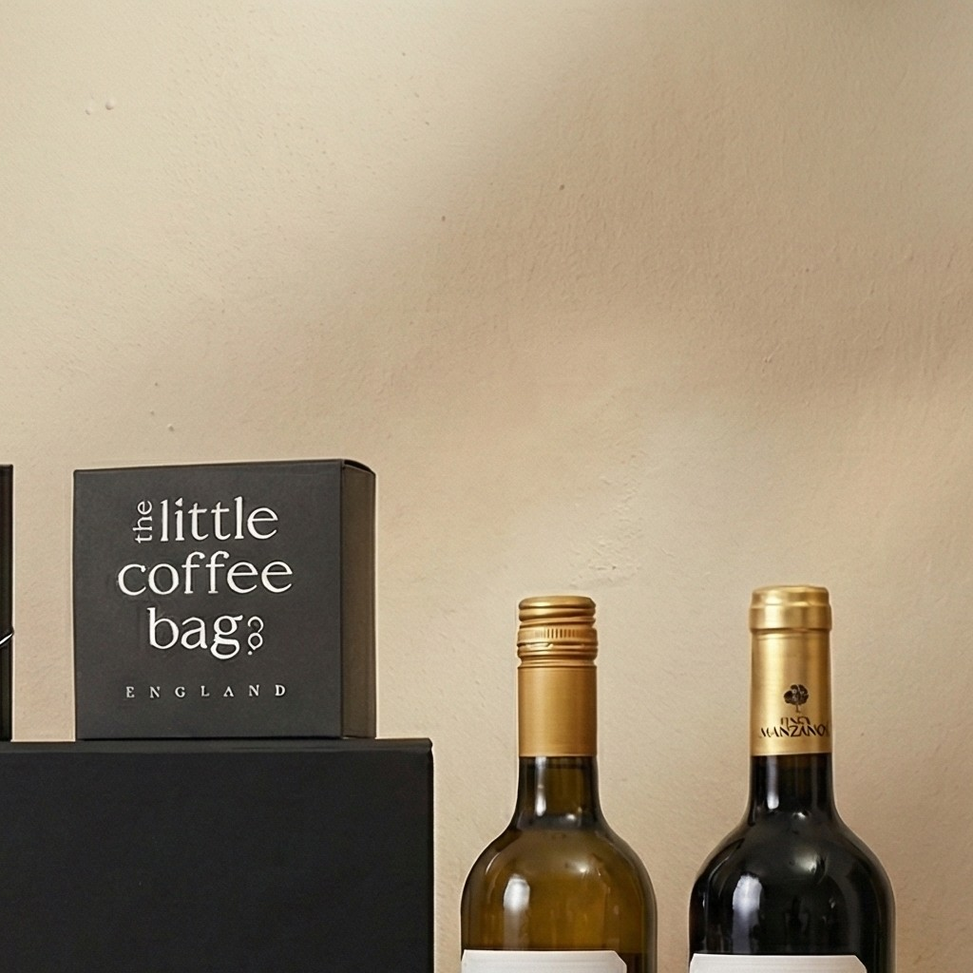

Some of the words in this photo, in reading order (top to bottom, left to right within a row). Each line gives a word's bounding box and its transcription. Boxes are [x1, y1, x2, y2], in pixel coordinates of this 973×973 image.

[132, 500, 153, 543] the
[160, 496, 279, 542] little
[117, 550, 293, 596] coffee
[147, 606, 244, 660] bag
[125, 684, 286, 699] ENGLAND
